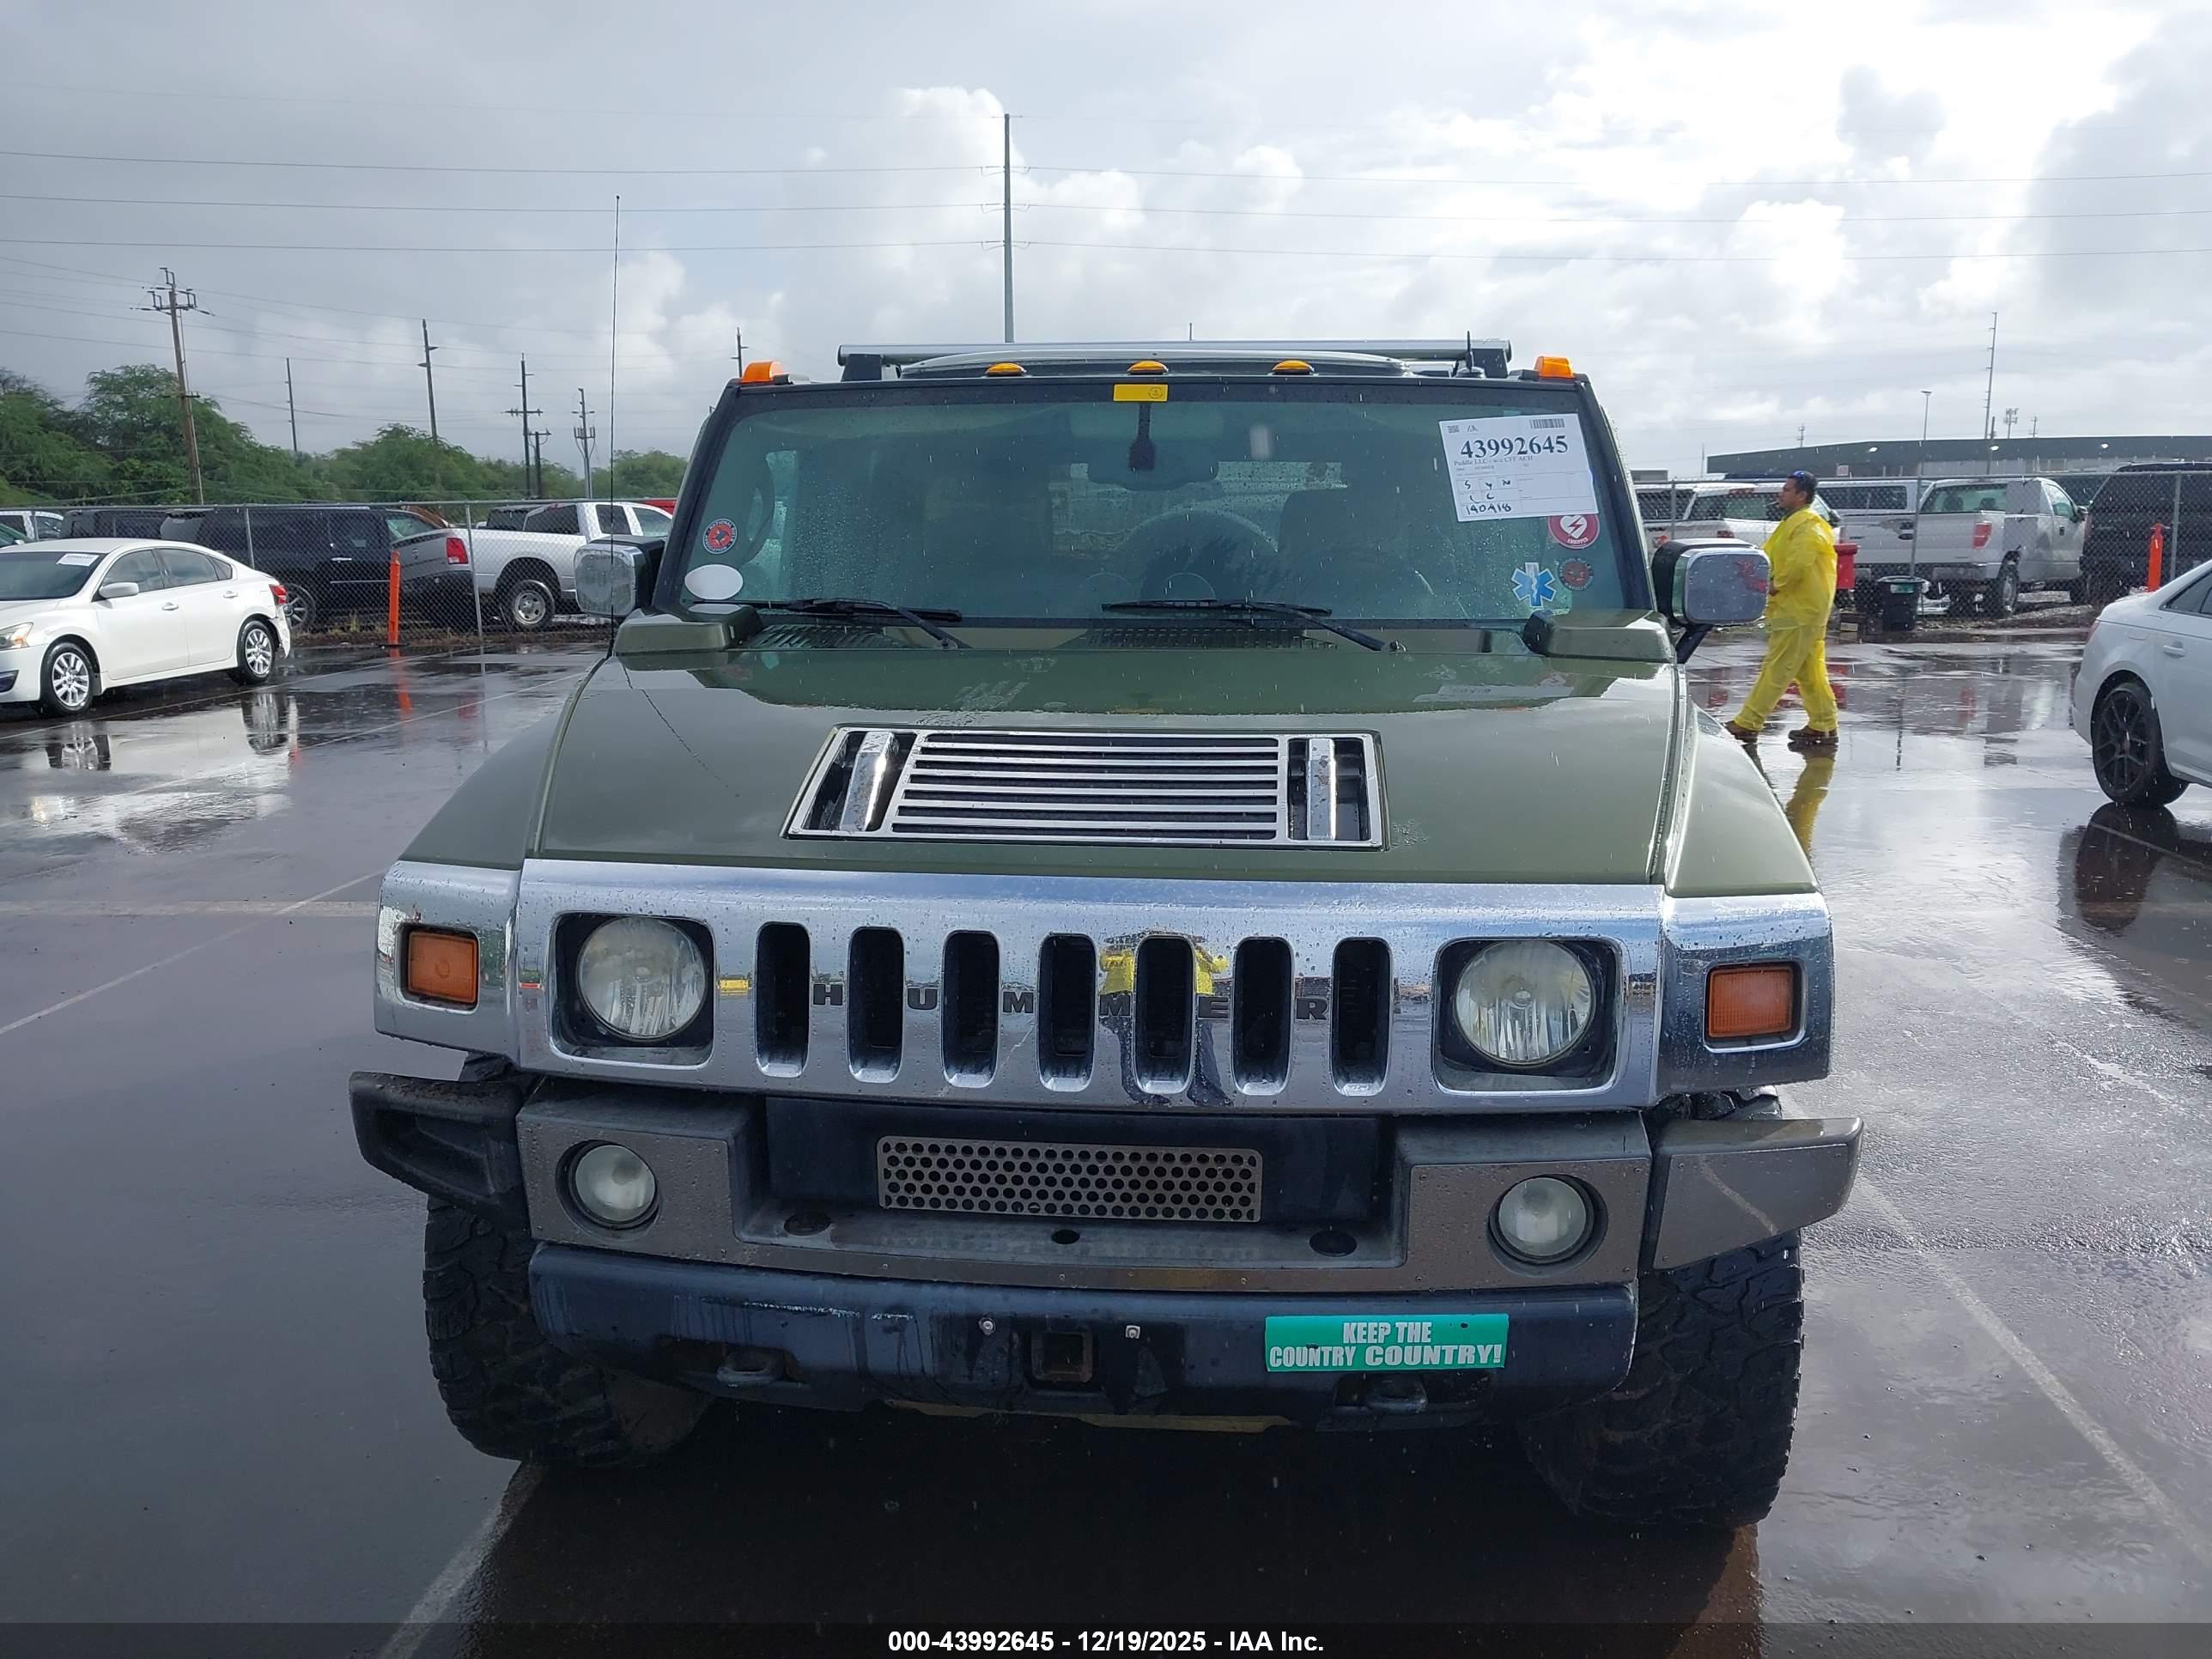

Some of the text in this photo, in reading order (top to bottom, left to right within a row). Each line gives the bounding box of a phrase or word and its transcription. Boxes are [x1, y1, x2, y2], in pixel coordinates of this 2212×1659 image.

[1460, 434, 1569, 459] 43992645
[1343, 1322, 1432, 1344] KEEP THE
[1269, 1344, 1503, 1367] COUNTRY COUNTRY!
